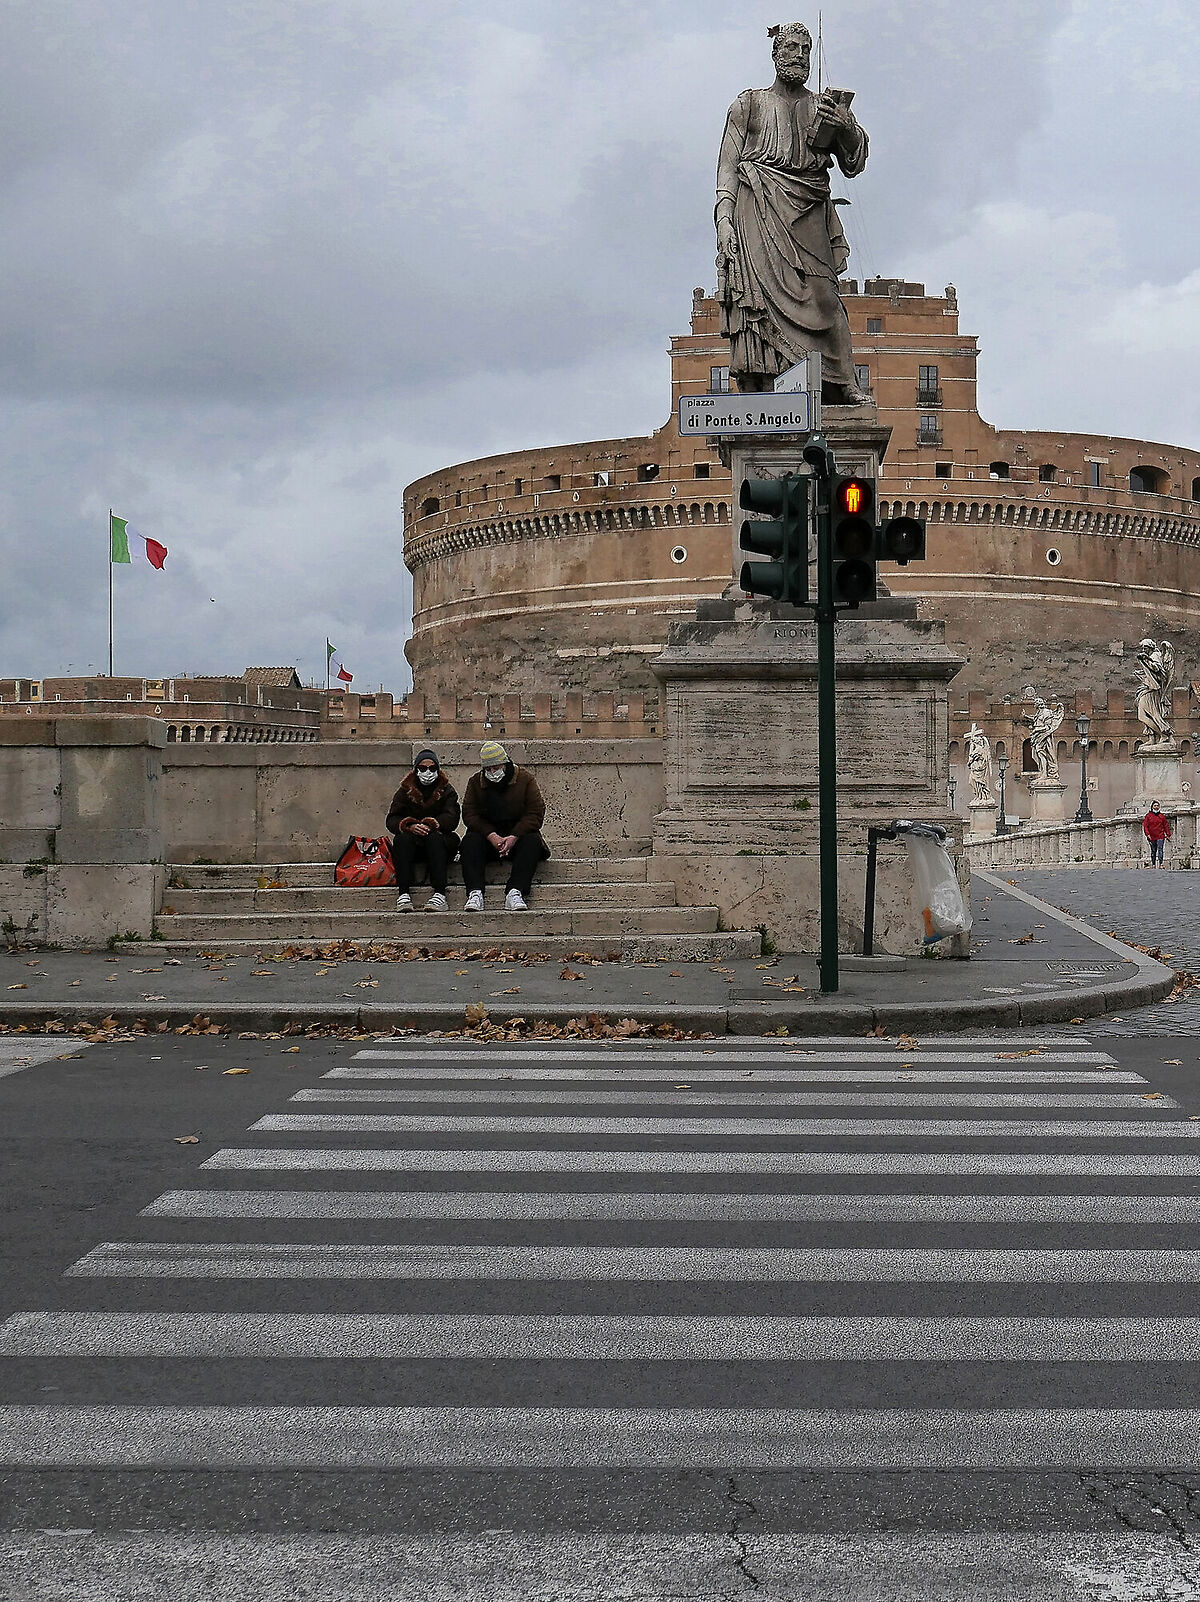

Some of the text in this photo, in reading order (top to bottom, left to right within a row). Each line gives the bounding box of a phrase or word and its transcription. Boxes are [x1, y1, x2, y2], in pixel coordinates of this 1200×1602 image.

[687, 398, 715, 408] piazza
[688, 411, 802, 428] di Ponte S.Angelo
[773, 628, 817, 638] RIONE
